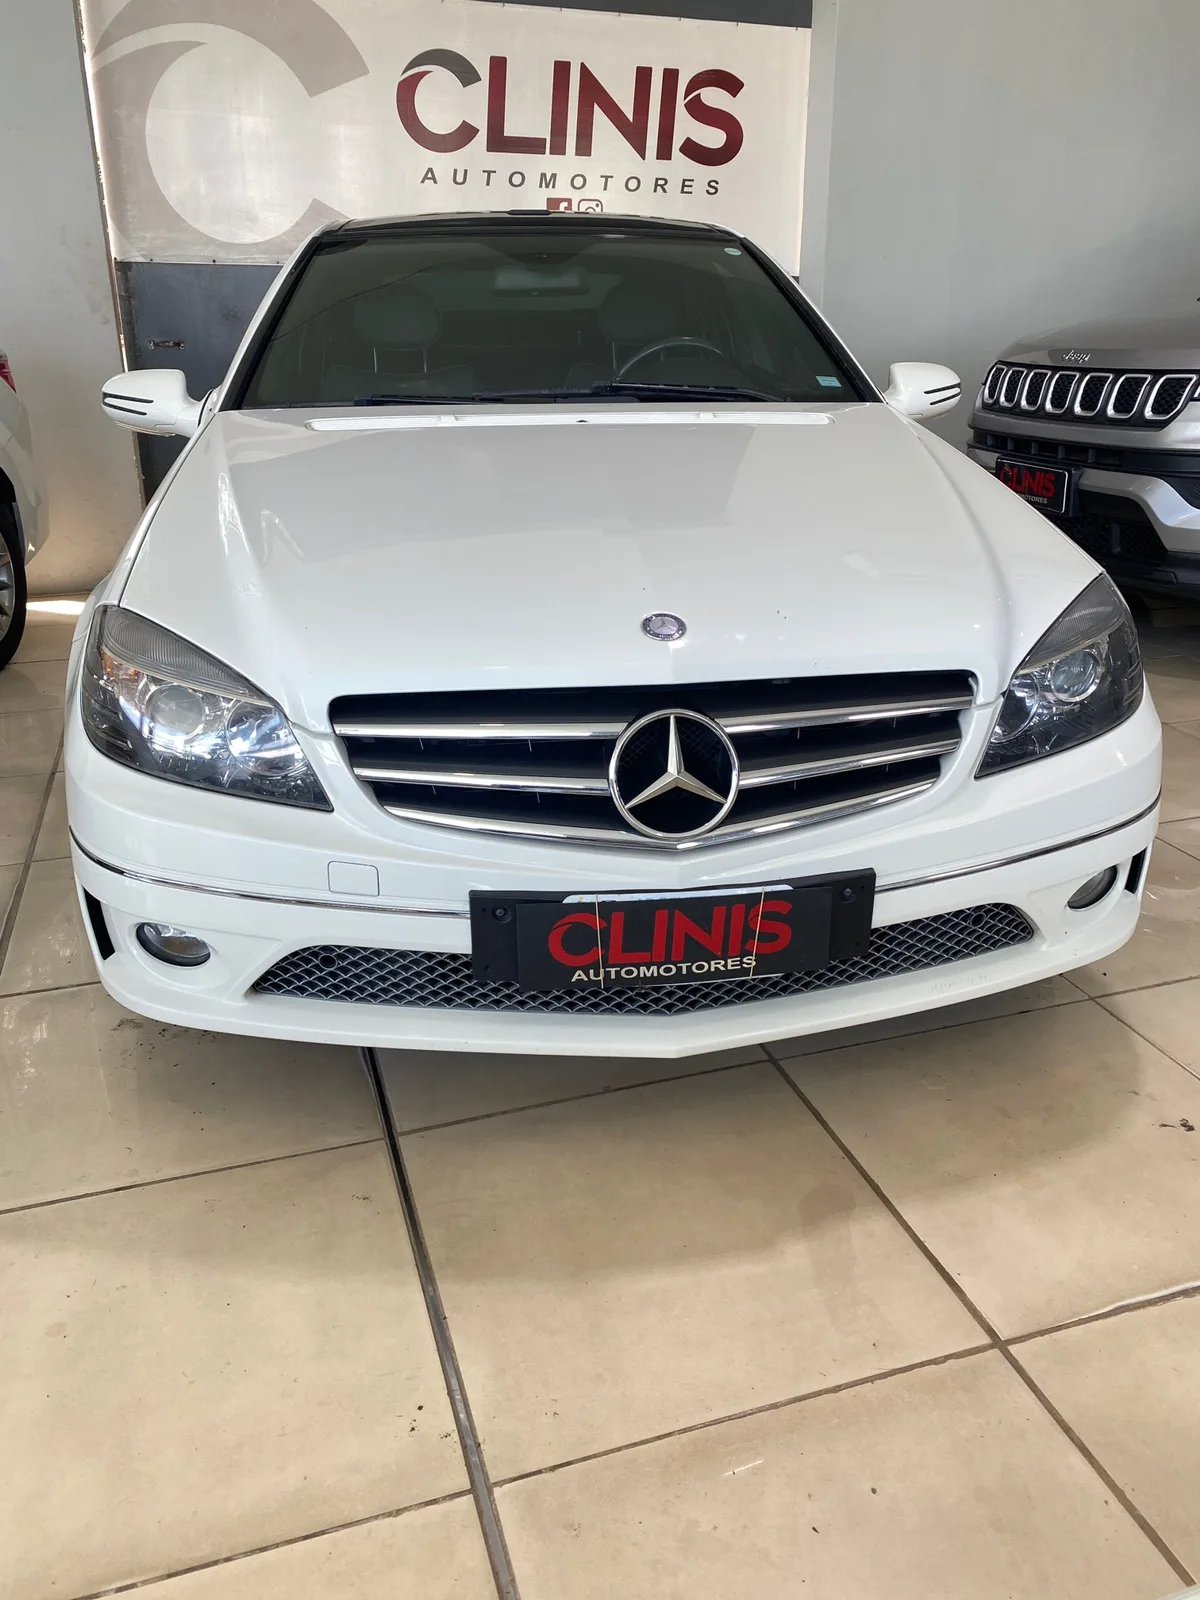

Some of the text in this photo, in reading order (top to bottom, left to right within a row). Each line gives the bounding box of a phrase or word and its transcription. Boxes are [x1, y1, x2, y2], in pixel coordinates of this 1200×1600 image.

[396, 48, 745, 167] CLINIS
[420, 167, 721, 195] AUTOMOTORES
[999, 464, 1056, 498] CLINIS
[548, 900, 792, 966] CLINIS
[571, 956, 757, 982] AUTOMOTORES
